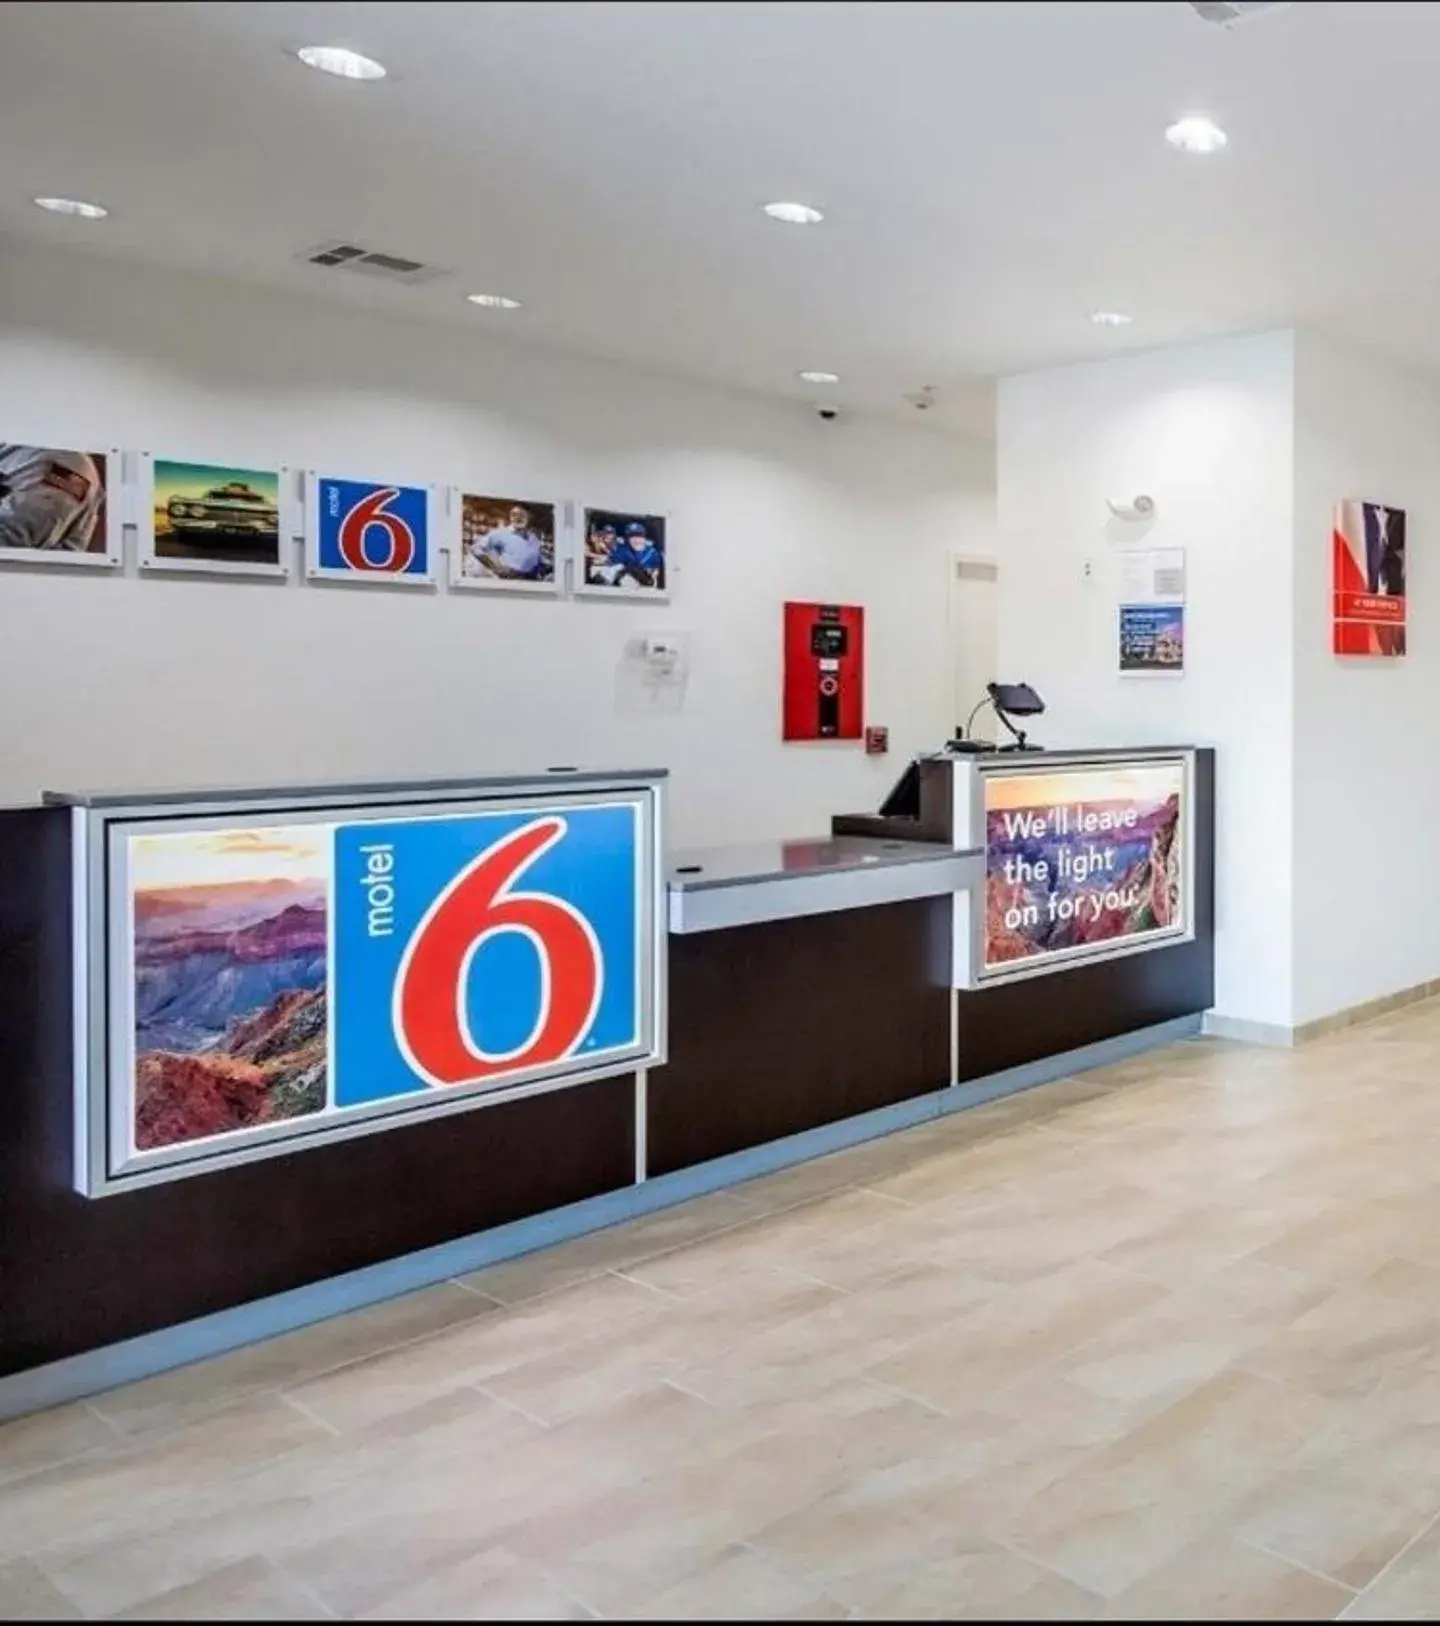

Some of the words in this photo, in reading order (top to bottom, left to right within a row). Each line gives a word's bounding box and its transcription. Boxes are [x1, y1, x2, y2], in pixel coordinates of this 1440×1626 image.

[338, 486, 415, 574] 6
[1003, 806, 1068, 841] We'll
[1077, 804, 1138, 832] leave
[1003, 853, 1049, 885] the
[1058, 844, 1114, 883] light
[1004, 904, 1038, 930] on
[1047, 890, 1085, 922] for
[359, 843, 395, 938] motel
[391, 815, 605, 1089] 6
